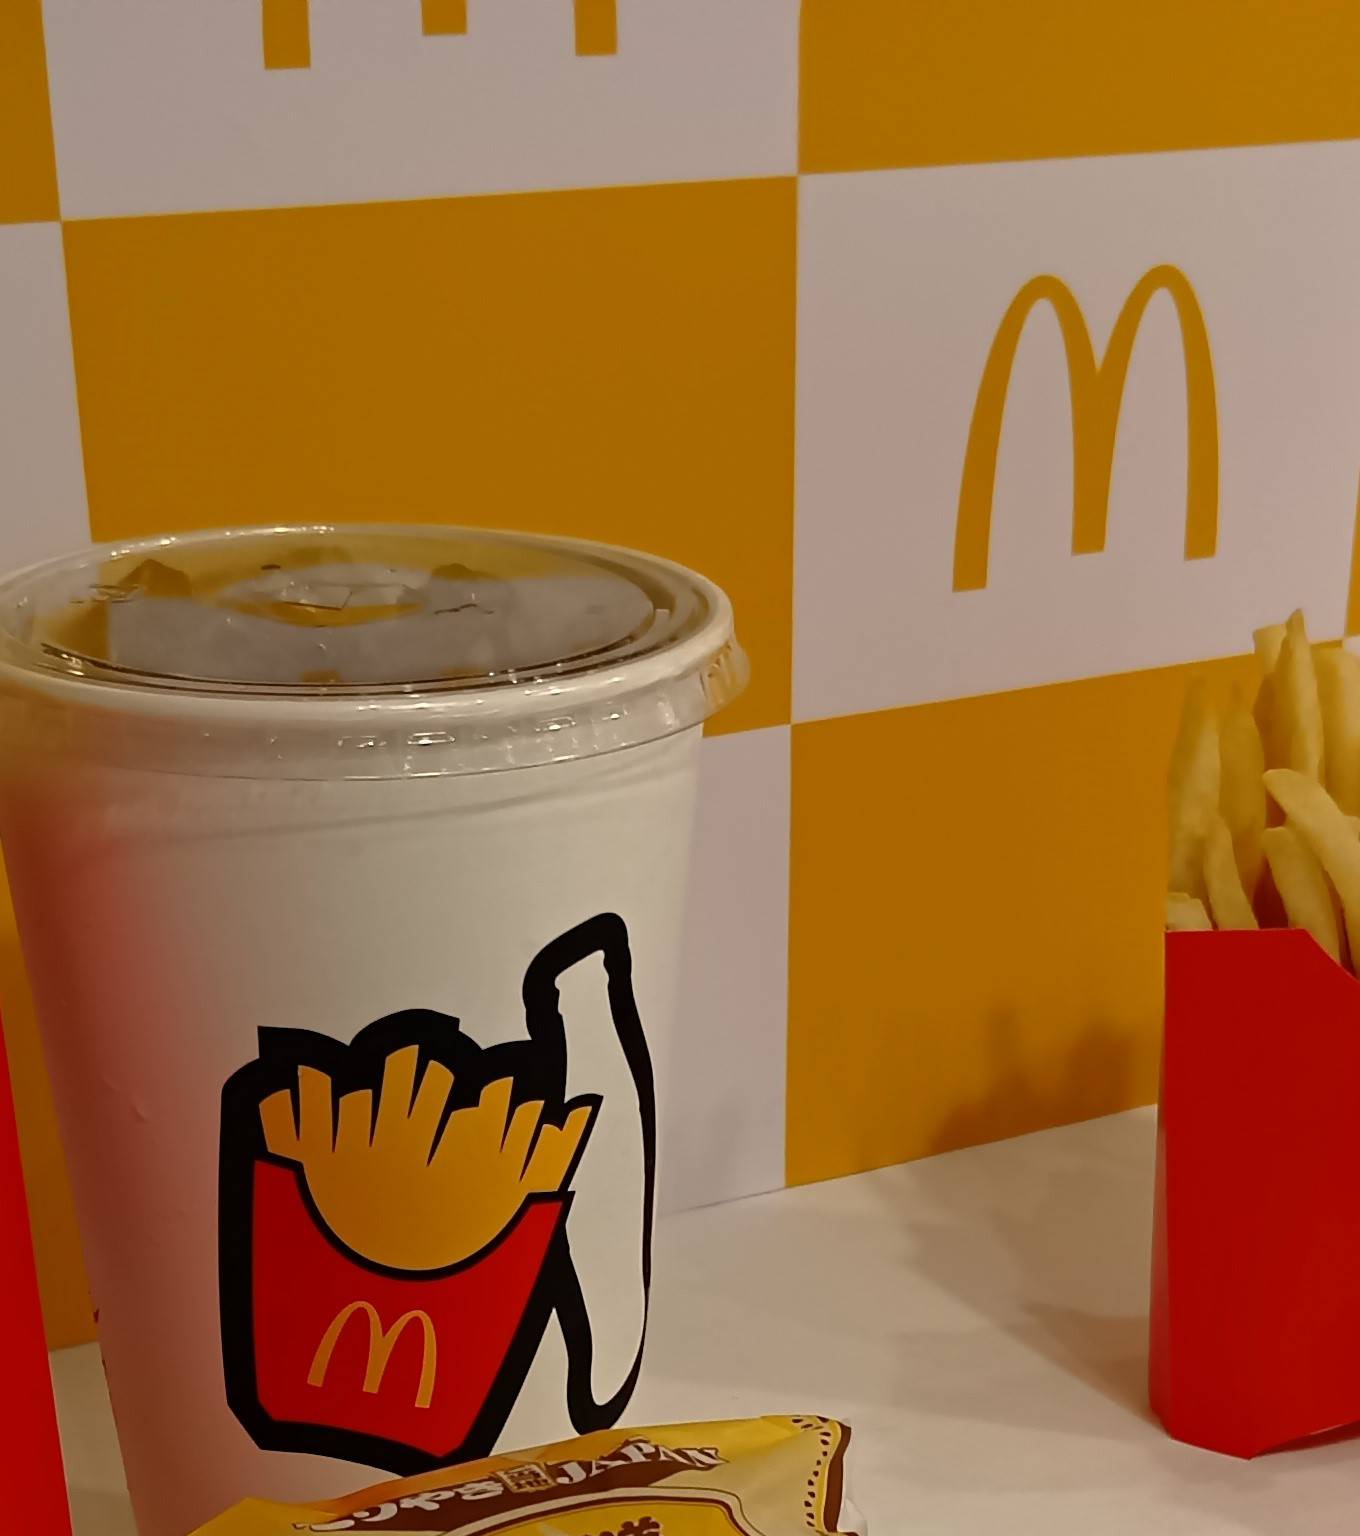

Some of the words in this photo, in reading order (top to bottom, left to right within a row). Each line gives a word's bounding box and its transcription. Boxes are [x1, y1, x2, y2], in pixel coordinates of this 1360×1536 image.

[952, 264, 1219, 593] M
[307, 1301, 436, 1408] M
[556, 1438, 724, 1485] JAPAN
